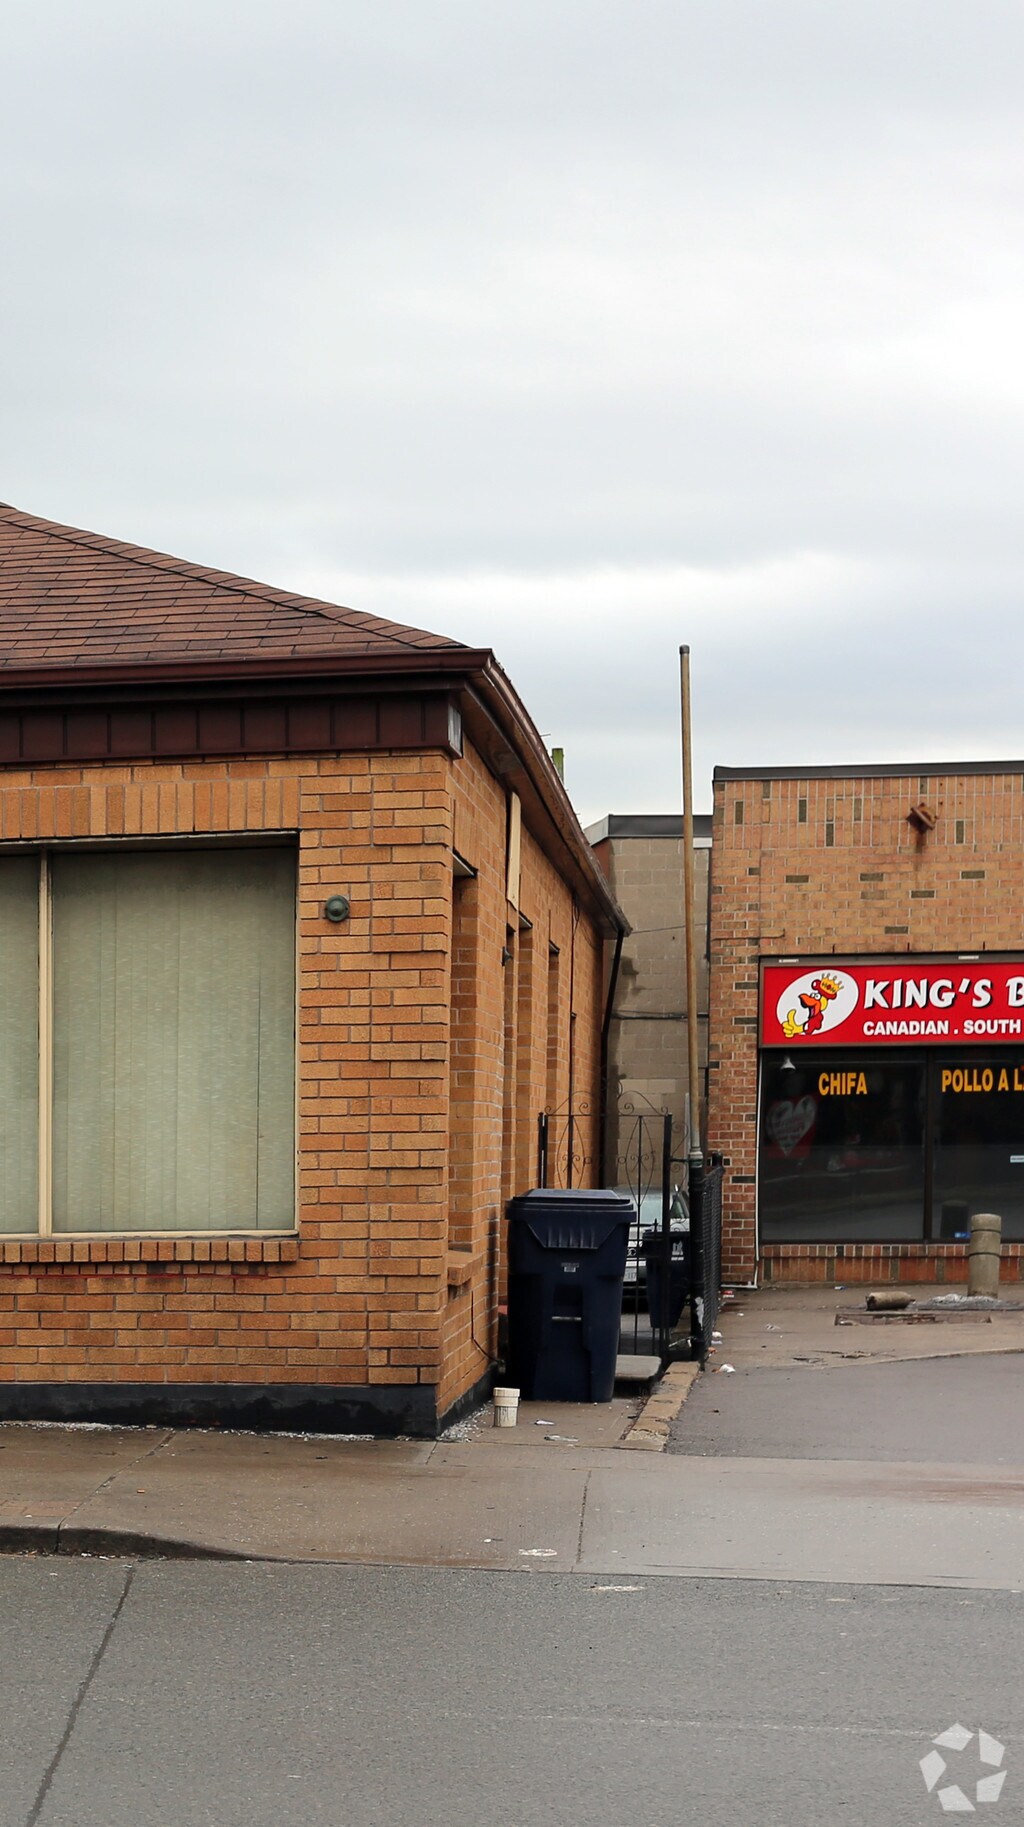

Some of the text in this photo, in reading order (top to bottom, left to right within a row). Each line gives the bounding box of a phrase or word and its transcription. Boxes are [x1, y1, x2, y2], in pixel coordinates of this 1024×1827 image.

[863, 978, 992, 1009] KING'S
[863, 1020, 949, 1036] CANADIAN
[963, 1018, 1021, 1035] SOUTH
[818, 1072, 868, 1096] CHIFA
[942, 1067, 1024, 1093] POLLO A L
